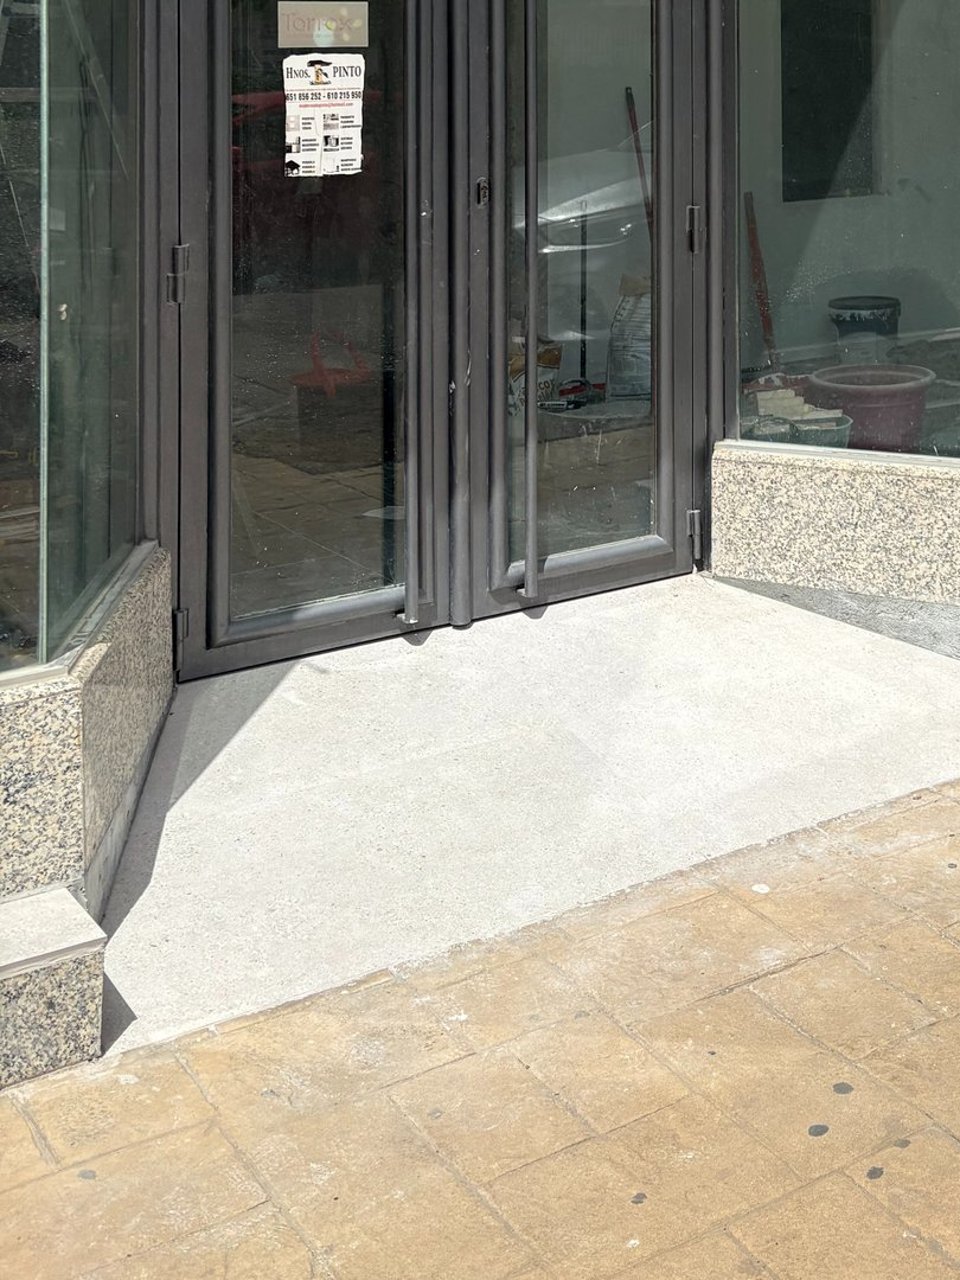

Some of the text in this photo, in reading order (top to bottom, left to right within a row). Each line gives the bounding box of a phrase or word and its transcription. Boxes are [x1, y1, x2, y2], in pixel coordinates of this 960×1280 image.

[332, 65, 362, 78] PINTO
[310, 91, 322, 101] 252
[326, 91, 339, 100] 610
[339, 91, 351, 100] 215
